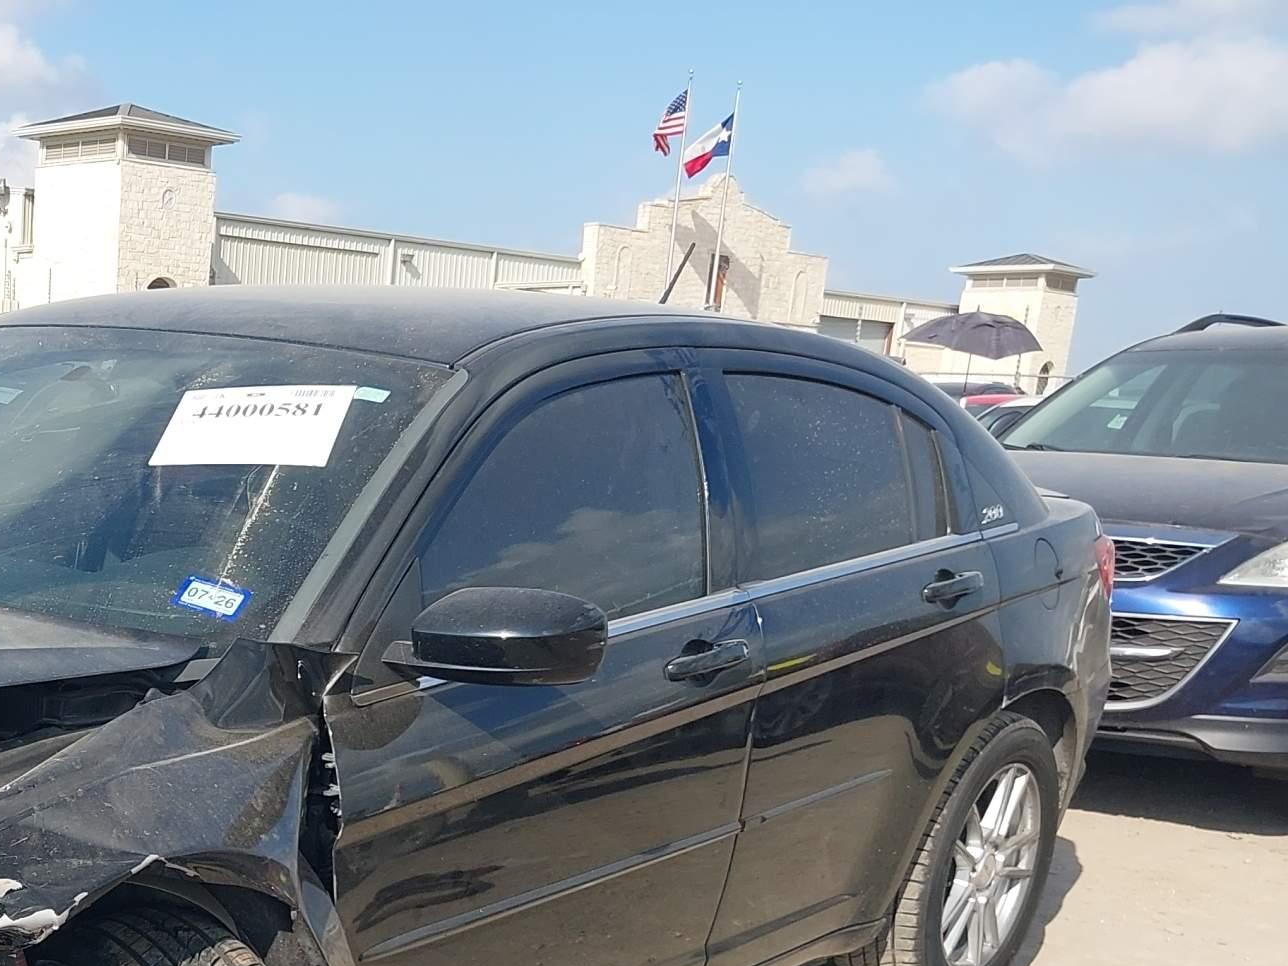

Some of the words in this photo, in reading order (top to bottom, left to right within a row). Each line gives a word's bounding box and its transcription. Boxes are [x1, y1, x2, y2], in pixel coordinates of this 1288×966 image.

[192, 403, 323, 418] 44000581
[187, 587, 209, 600] 07
[214, 595, 236, 609] 26
